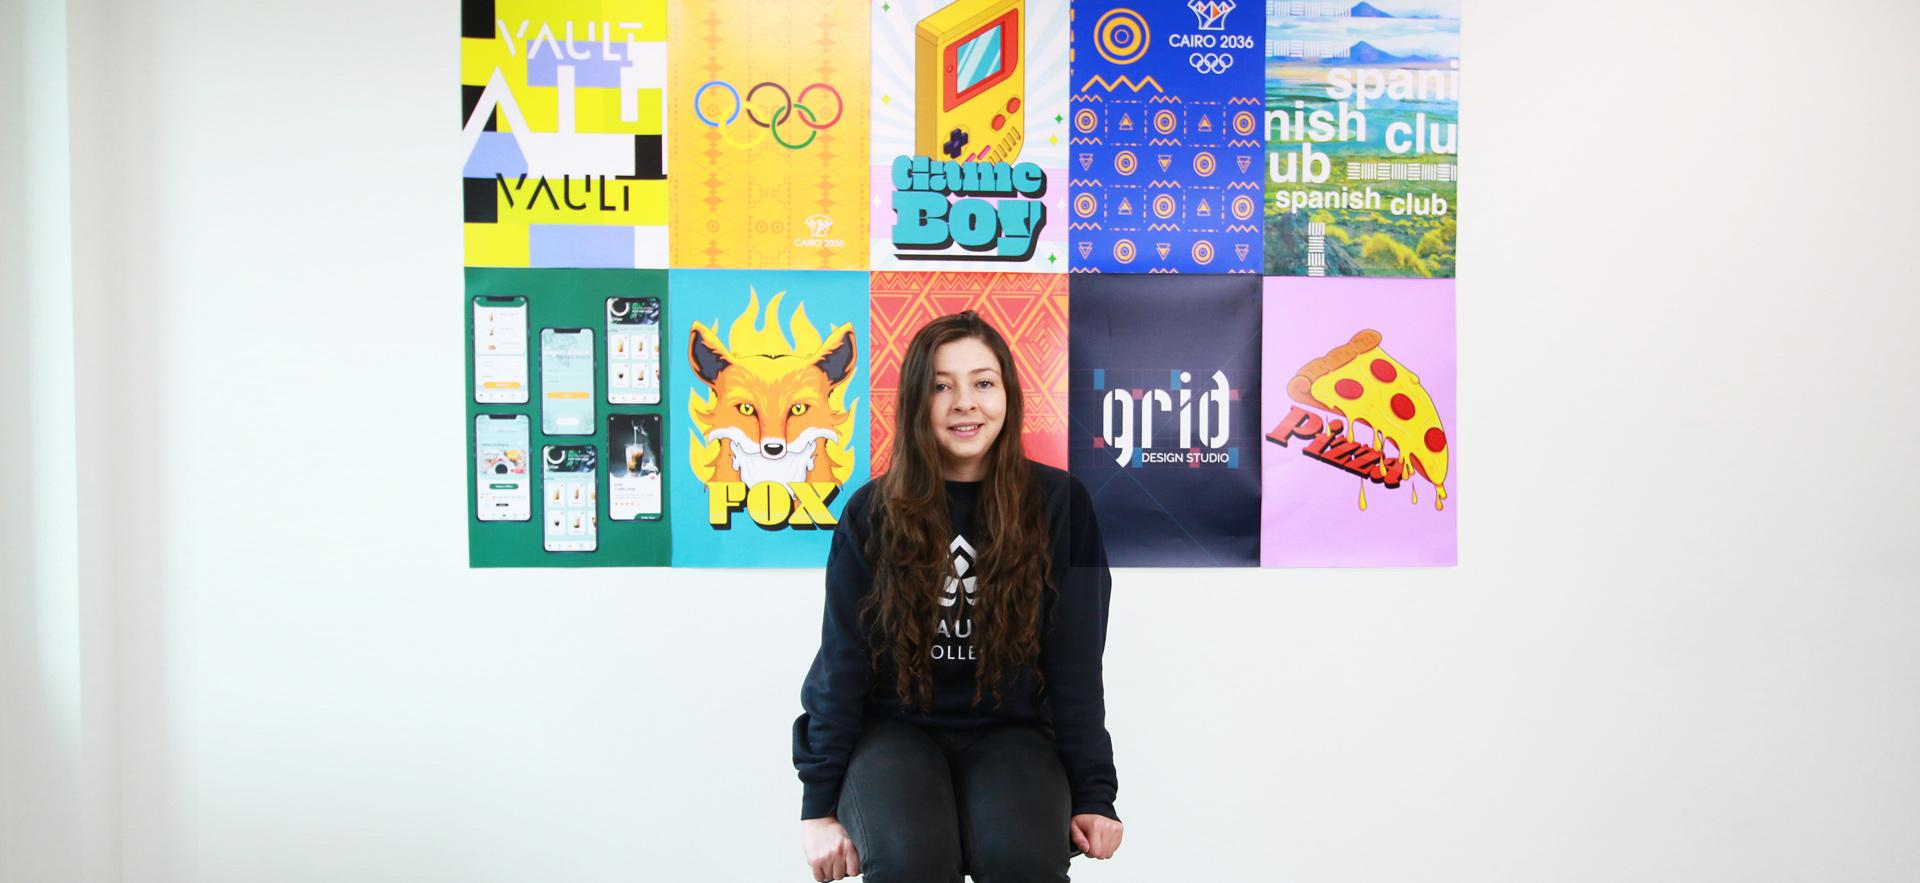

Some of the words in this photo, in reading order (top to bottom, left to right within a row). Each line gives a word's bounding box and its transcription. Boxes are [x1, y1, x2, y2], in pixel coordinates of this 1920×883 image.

[497, 20, 643, 61] VAULT
[1169, 34, 1216, 48] CAIRO
[1220, 35, 1254, 49] 2036
[1326, 60, 1459, 110] spani
[1265, 100, 1367, 142] nish
[1385, 112, 1457, 154] clu
[892, 155, 1047, 198] Game
[1269, 142, 1331, 183] ub
[496, 173, 641, 211] VAULT
[1275, 186, 1381, 213] spanish
[1390, 193, 1448, 215] club
[892, 191, 1047, 262] Boy
[1103, 370, 1230, 467] grid
[1142, 453, 1184, 463] DESIGN
[1186, 453, 1229, 463] STUDIO
[708, 481, 840, 531] FOX
[930, 644, 978, 660] OLLE
